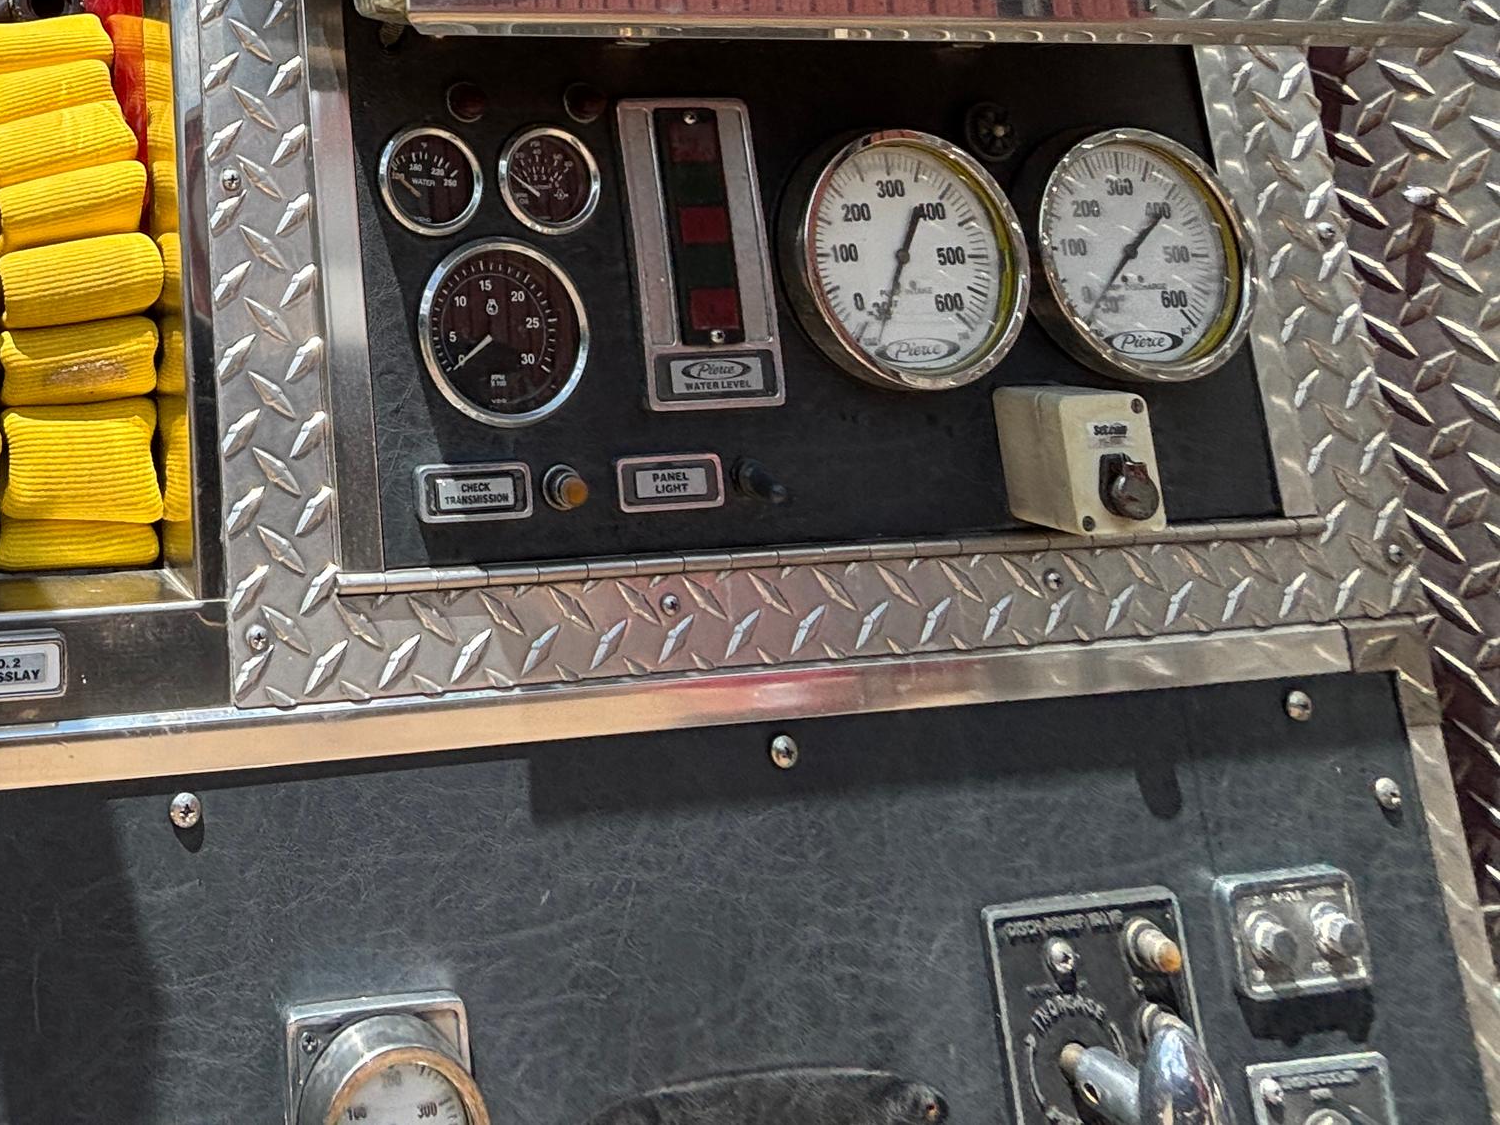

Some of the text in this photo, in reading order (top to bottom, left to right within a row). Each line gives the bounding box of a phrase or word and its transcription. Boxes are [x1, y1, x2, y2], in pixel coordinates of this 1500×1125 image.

[412, 177, 436, 187] WATER
[876, 179, 905, 198] 300
[1105, 178, 1133, 196] 300
[842, 203, 871, 222] 200
[917, 202, 946, 221] 400
[1071, 200, 1100, 218] 200
[1145, 202, 1171, 220] 400
[831, 243, 858, 263] 100
[936, 246, 966, 265] 500
[1060, 238, 1087, 257] 100
[1162, 246, 1190, 264] 500
[479, 280, 493, 291] 15
[454, 296, 467, 307] 10
[511, 291, 525, 302] 20
[853, 292, 865, 311] 0
[934, 292, 964, 312] 600
[1161, 290, 1188, 308] 600
[525, 317, 540, 329] 25
[449, 331, 457, 343] 5
[1120, 334, 1166, 351] Pierce
[521, 353, 535, 365] 30
[895, 342, 941, 360] Pierce
[697, 362, 735, 377] Pierce
[684, 380, 752, 391] WATER LEVEL
[652, 472, 690, 483] PANEL
[461, 482, 491, 493] CHECK
[655, 483, 689, 494] LIGHT
[444, 494, 510, 506] TRANSMISSION
[12, 657, 21, 669] 2
[418, 1102, 438, 1119] 300
